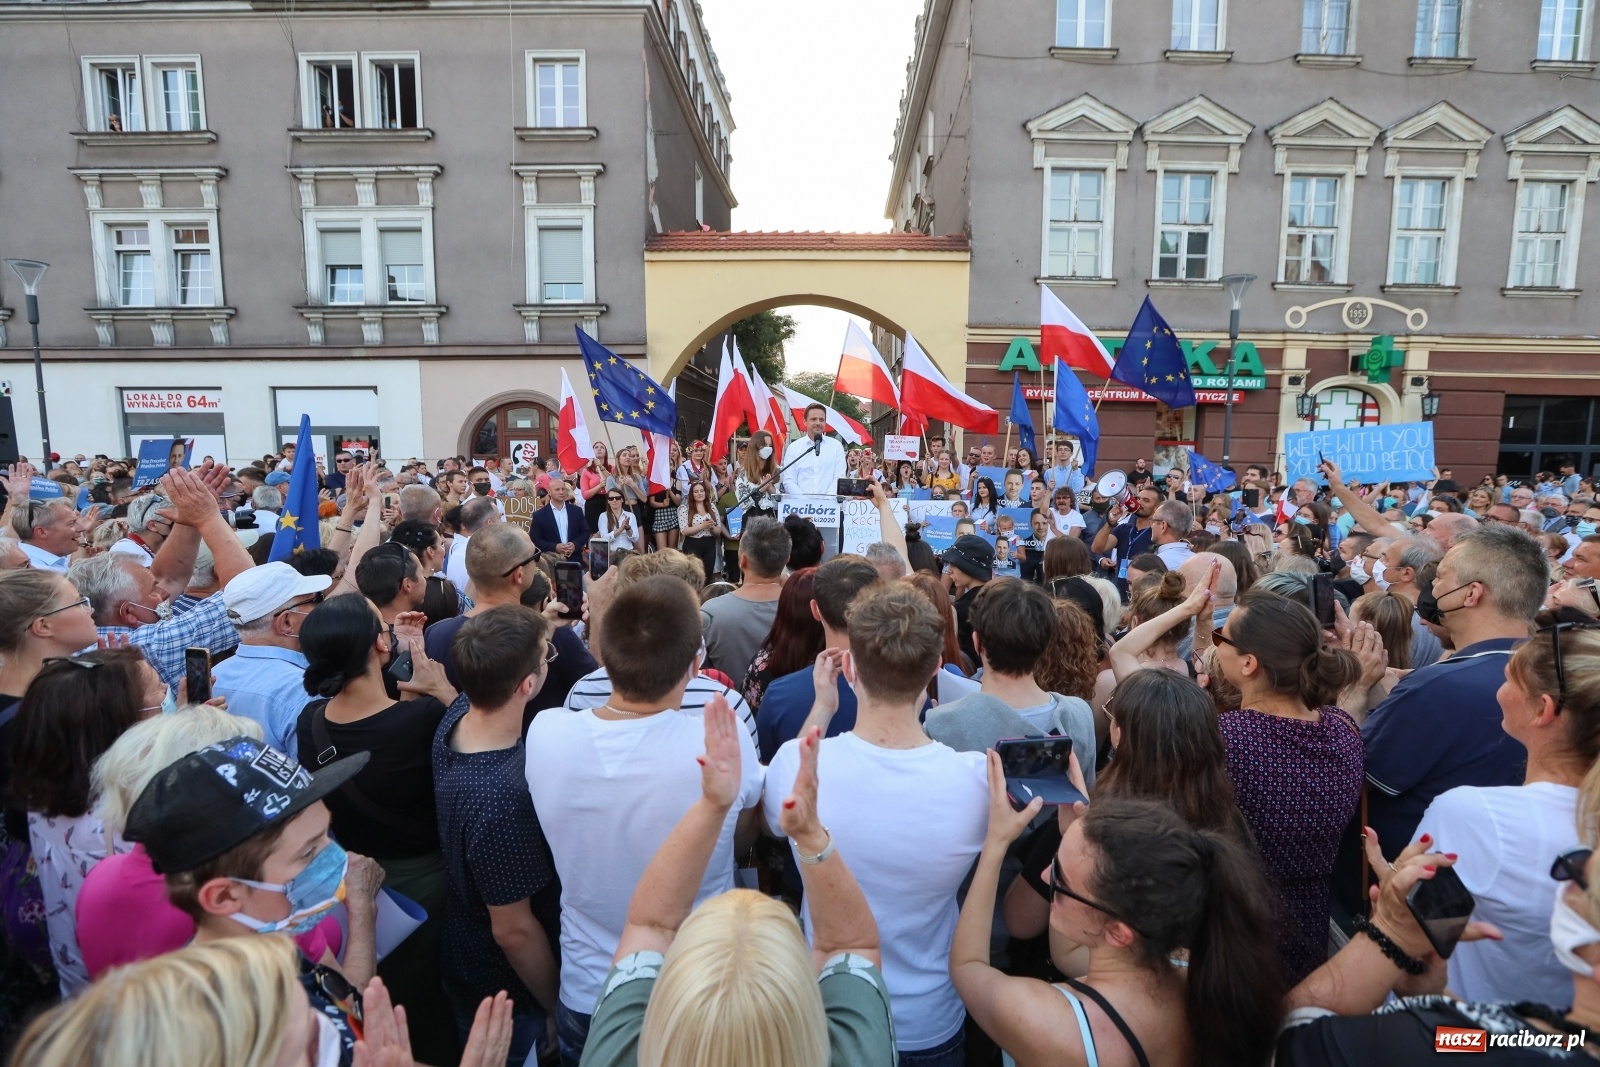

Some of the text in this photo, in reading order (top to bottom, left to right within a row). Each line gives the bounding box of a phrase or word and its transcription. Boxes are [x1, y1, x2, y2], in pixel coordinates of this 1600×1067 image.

[1350, 309, 1367, 318] 1953
[126, 393, 182, 401] LOKAL DO
[1026, 389, 1054, 397] RYNE
[1087, 390, 1139, 399] CENTRUM
[126, 400, 183, 410] WYNAJĘCIA
[1288, 427, 1431, 459] WE'RE WITH YOU
[1289, 457, 1318, 476] YOU
[1382, 451, 1401, 471] BE
[782, 503, 837, 516] Racibórz
